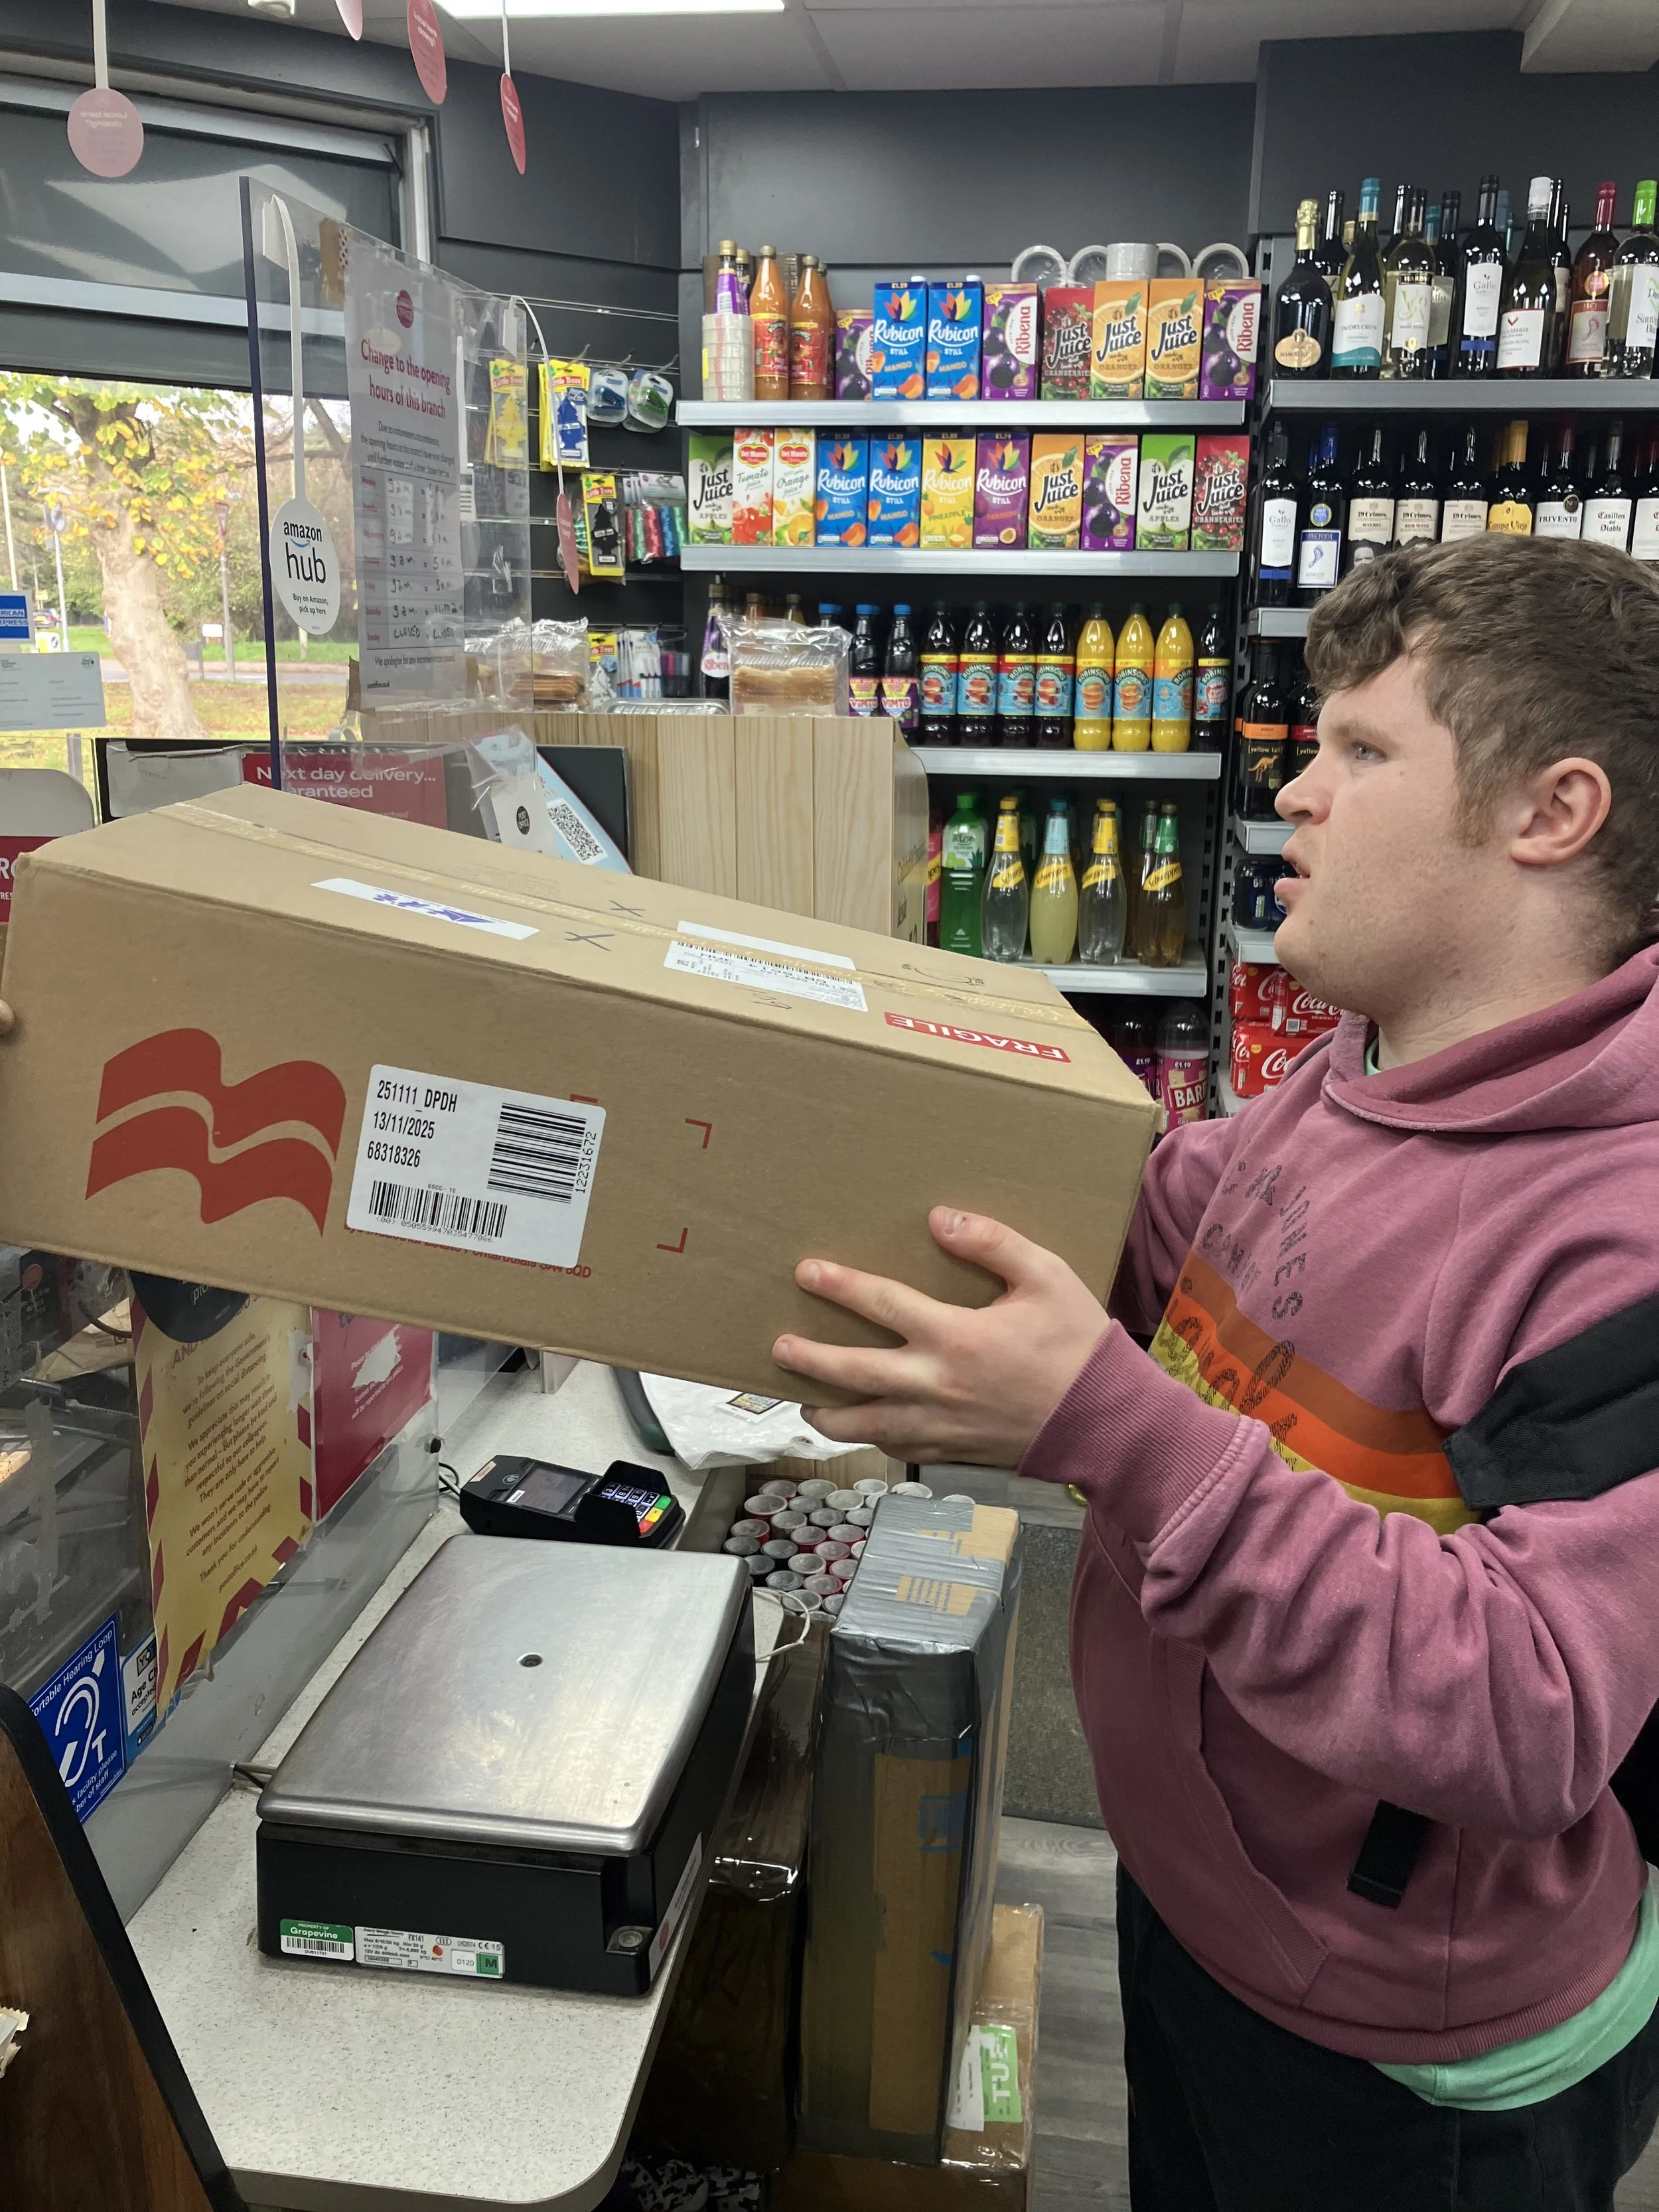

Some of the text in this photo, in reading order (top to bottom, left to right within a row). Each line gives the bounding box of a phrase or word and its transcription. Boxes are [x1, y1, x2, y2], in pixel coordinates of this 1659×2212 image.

[873, 318, 924, 343] Rubicon
[928, 318, 979, 344] Rubicon
[1014, 305, 1032, 356] Ribena
[1237, 302, 1255, 352] Ribena
[360, 338, 451, 396] Change to the opening
[565, 376, 581, 386] Trees
[369, 374, 446, 419] hours of this branch
[737, 468, 769, 484] Tomato
[777, 474, 810, 489] Orange
[817, 469, 865, 492] Rubicon
[869, 469, 919, 492] Rubicon
[924, 469, 972, 492] Rubicon
[976, 469, 1027, 493] Rubicon
[1115, 457, 1132, 506] Ribena
[283, 521, 323, 543] amazon
[1269, 515, 1291, 524] Gallo
[1538, 515, 1578, 524] TRIVENTO
[285, 542, 326, 584] hub
[293, 593, 303, 603] Buy
[299, 605, 309, 615] pick
[316, 607, 326, 615] here
[1077, 668, 1110, 685] ROBINSONS
[1115, 668, 1148, 684] ROBINSONS
[881, 697, 912, 709] VIMTO
[311, 767, 345, 782] day
[518, 810, 528, 820] POST
[518, 819, 530, 830] OFFICE
[1148, 865, 1181, 889] Schweppes
[889, 1014, 1064, 1061] FRAGILE
[376, 1079, 458, 1114] 251111_DPDH
[372, 1110, 435, 1140] 13/11/2025
[367, 1140, 421, 1168] 68318326
[575, 1131, 597, 1194] 12231672
[199, 1374, 225, 1400] following
[188, 1396, 216, 1430] guidelines
[188, 1392, 251, 1451] We appreciate this may
[185, 1396, 261, 1474] you experiencing longer wait
[185, 1416, 257, 1487] than normal but please be
[196, 1445, 242, 1492] respectful to our
[199, 1447, 256, 1503] They are only here to
[186, 1473, 265, 1556] customers and we may have to
[189, 1479, 246, 1538] We won't serve rude
[202, 1500, 253, 1556] any incidents to the
[200, 1540, 238, 1582] Thank you for
[62, 1630, 113, 1686] Hearing Loop
[131, 1680, 147, 1705] Age
[77, 1772, 98, 1801] facility
[98, 1749, 118, 1777] please
[87, 1768, 109, 1799] of staff
[290, 1927, 338, 1939] Grapevine
[407, 1934, 425, 1943] FX141
[456, 1958, 475, 1967] 0120
[484, 1958, 498, 1968] M
